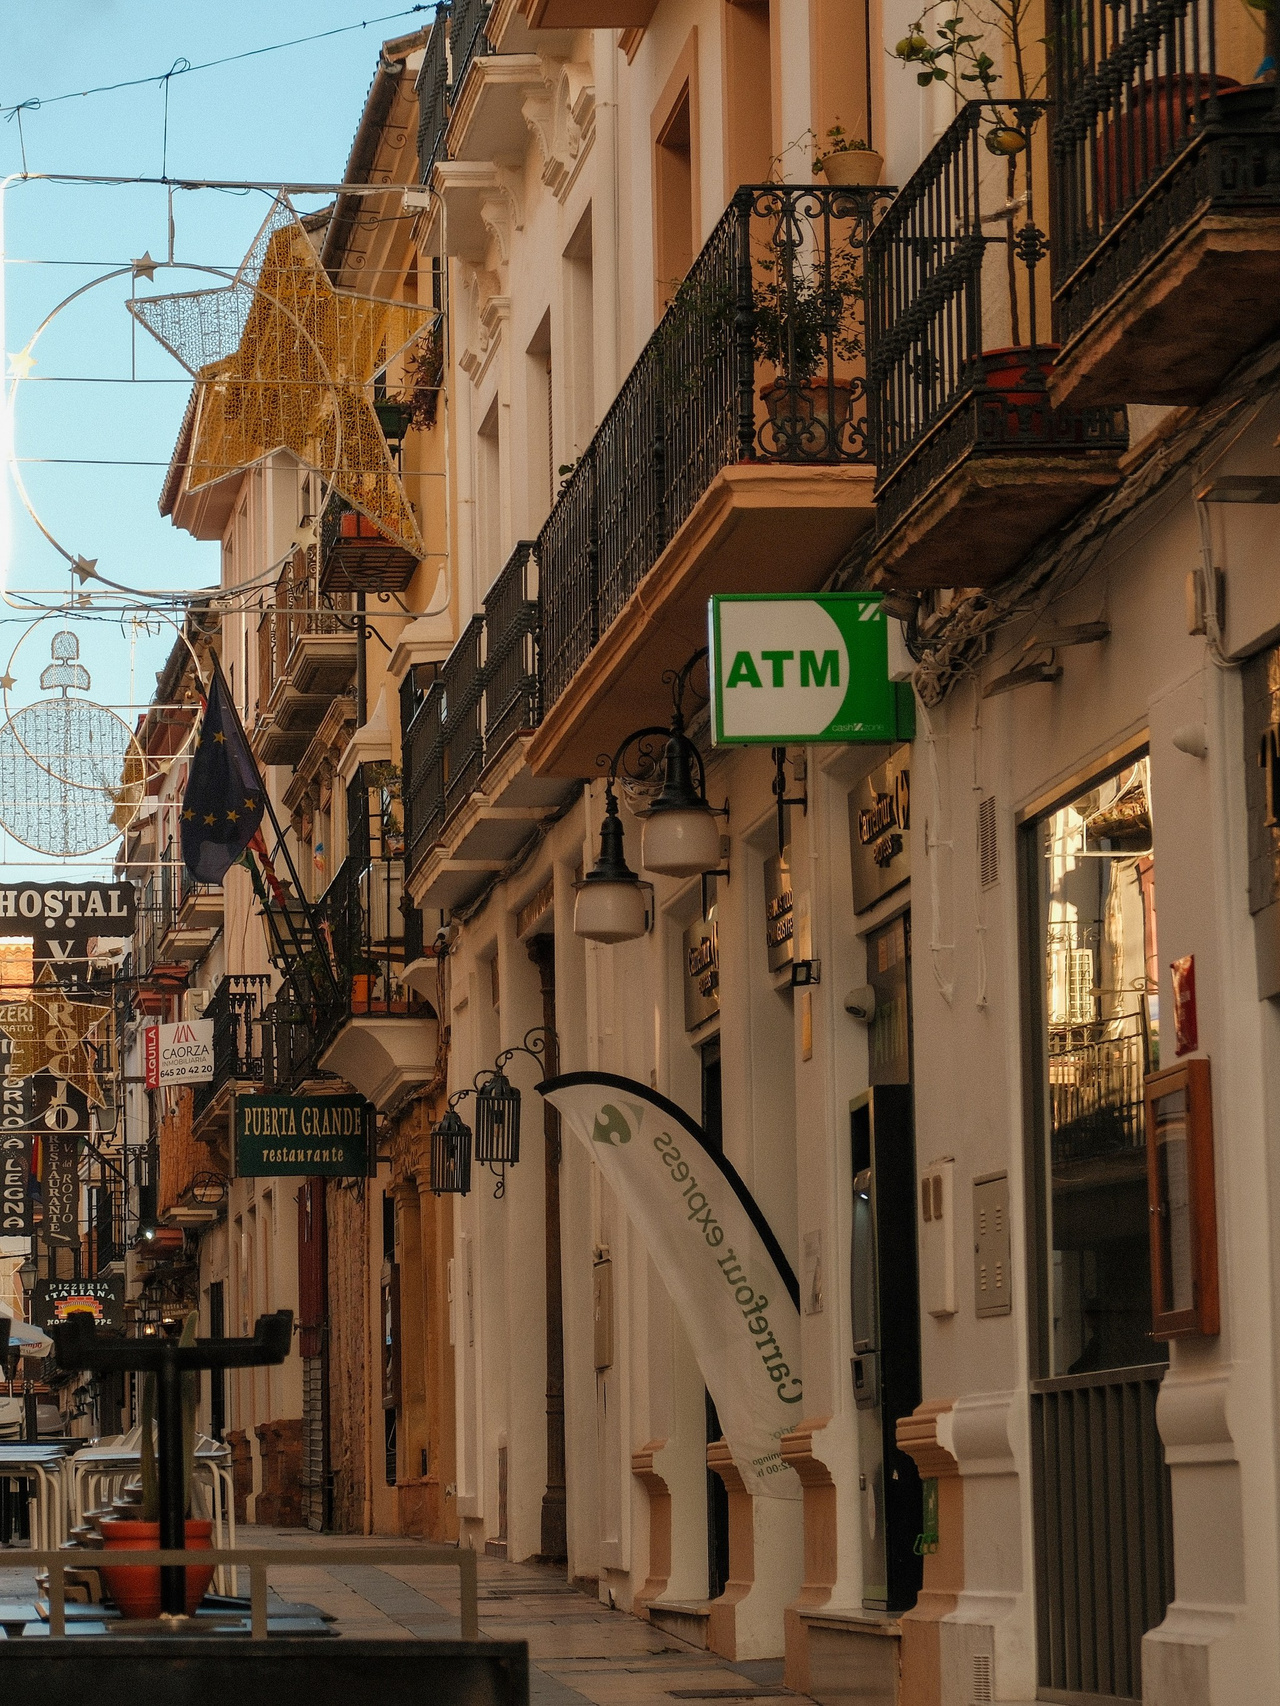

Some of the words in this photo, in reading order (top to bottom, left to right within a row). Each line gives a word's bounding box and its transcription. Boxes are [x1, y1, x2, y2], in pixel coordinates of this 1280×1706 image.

[726, 650, 840, 688] ATM
[148, 1029, 157, 1085] ALQUILA
[161, 1056, 208, 1067] INMOBILIARIA
[162, 1045, 210, 1060] CAORZA
[160, 1069, 175, 1078] 645
[176, 1067, 187, 1076] 20
[188, 1066, 200, 1074] 42
[201, 1065, 213, 1073] 20
[244, 1107, 296, 1138] PUERTA
[301, 1106, 362, 1137] GRANDE
[262, 1147, 345, 1163] restaurante
[2, 1158, 25, 1229] LEGNA
[48, 1135, 62, 1232] RESTAURANTE
[62, 1173, 74, 1224] ROCIO
[44, 1289, 116, 1301] ITALIANA
